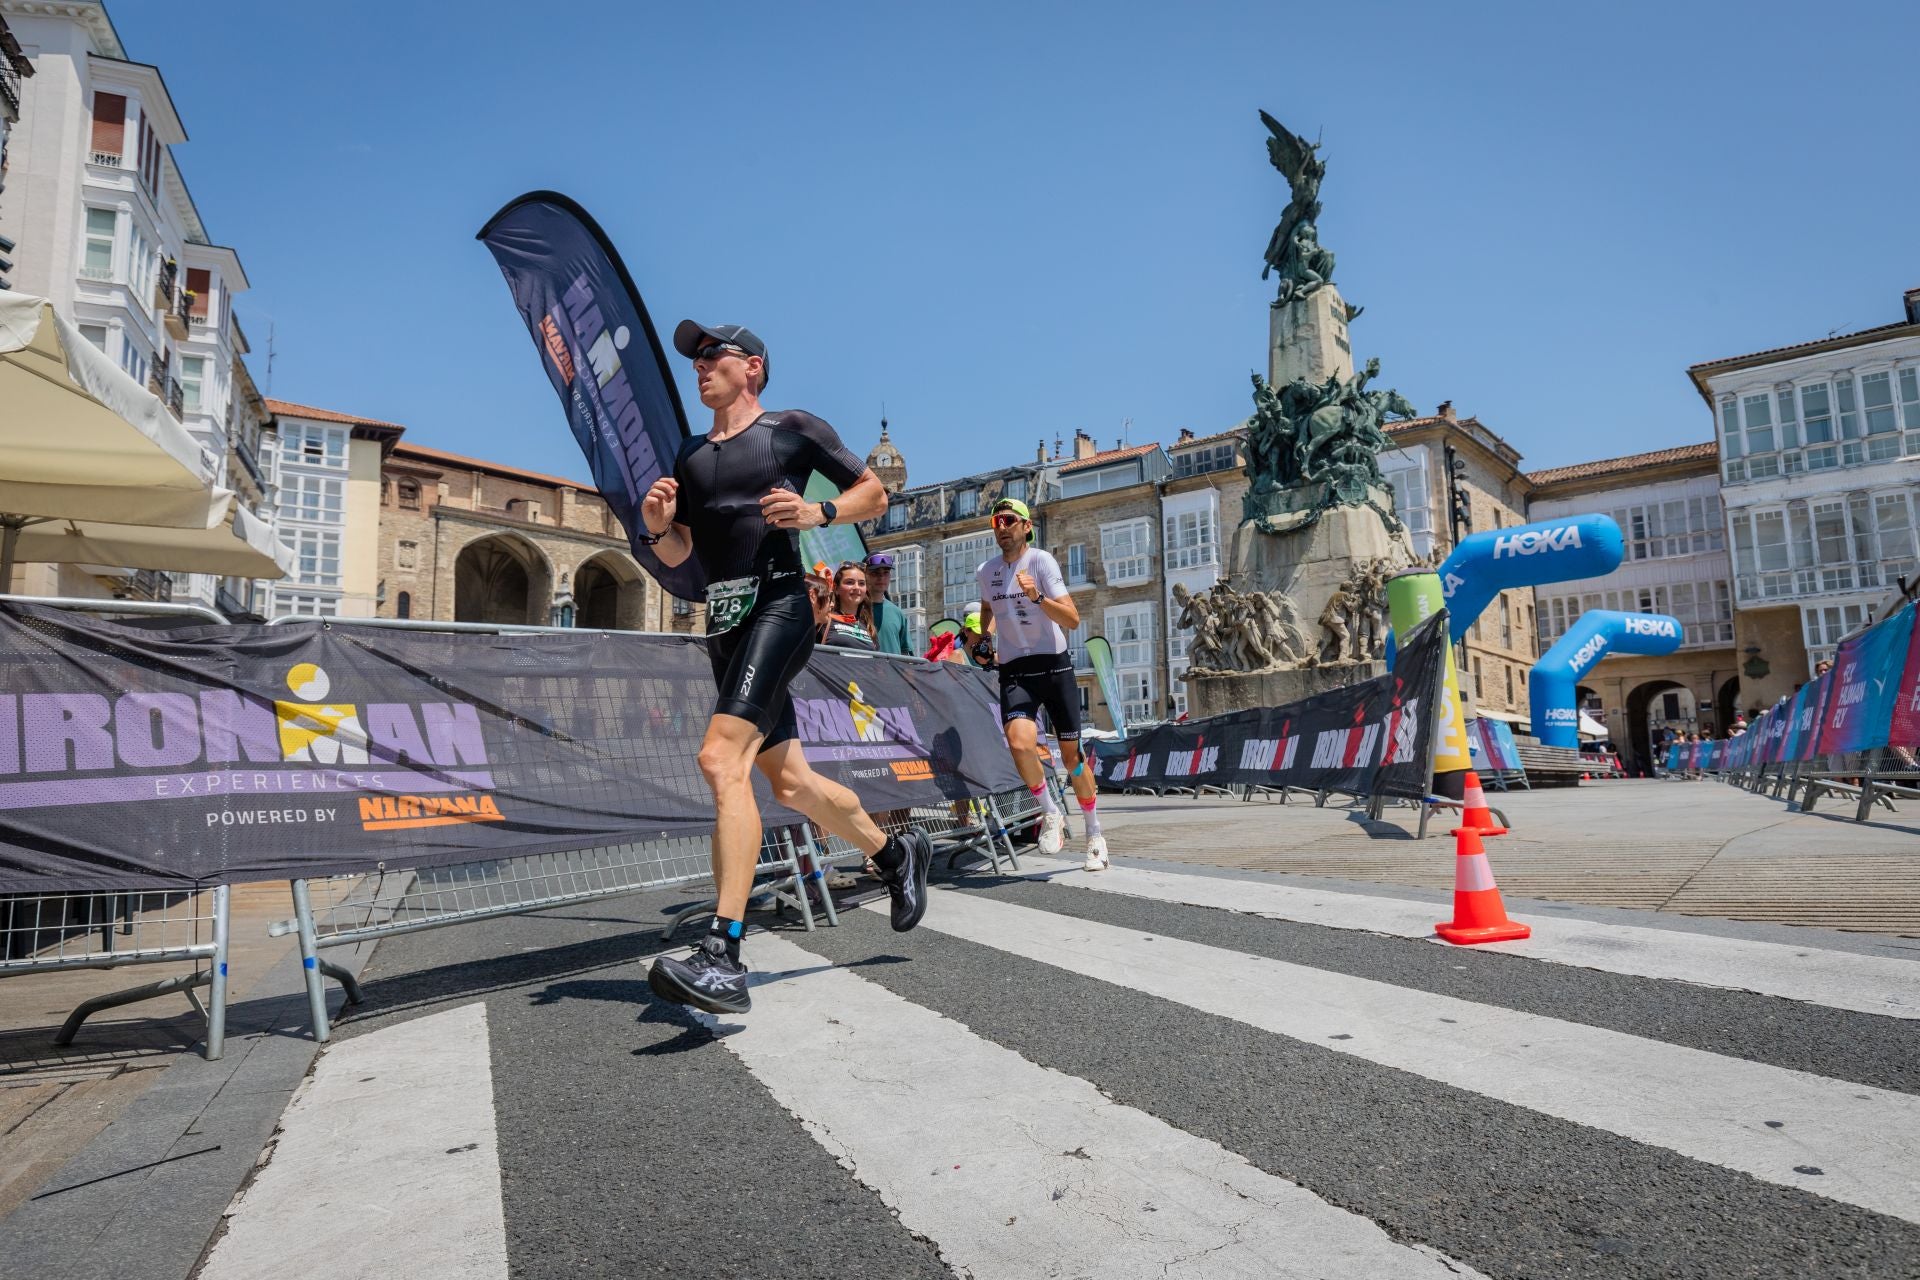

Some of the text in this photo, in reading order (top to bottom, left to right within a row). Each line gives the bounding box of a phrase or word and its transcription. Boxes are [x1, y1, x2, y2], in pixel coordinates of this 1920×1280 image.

[1493, 525, 1583, 560] HOKA
[1625, 617, 1676, 638] HOKA
[1568, 633, 1608, 673] HOKA
[740, 664, 756, 697] 2XU
[1843, 662, 1857, 684] FLY
[1838, 680, 1866, 706] HUMAN
[792, 697, 923, 744] RONMAN
[1832, 707, 1848, 729] FLY
[155, 772, 385, 796] EXPERIENCES
[206, 808, 337, 827] POWERED BY
[358, 794, 502, 821] NIRVANA
